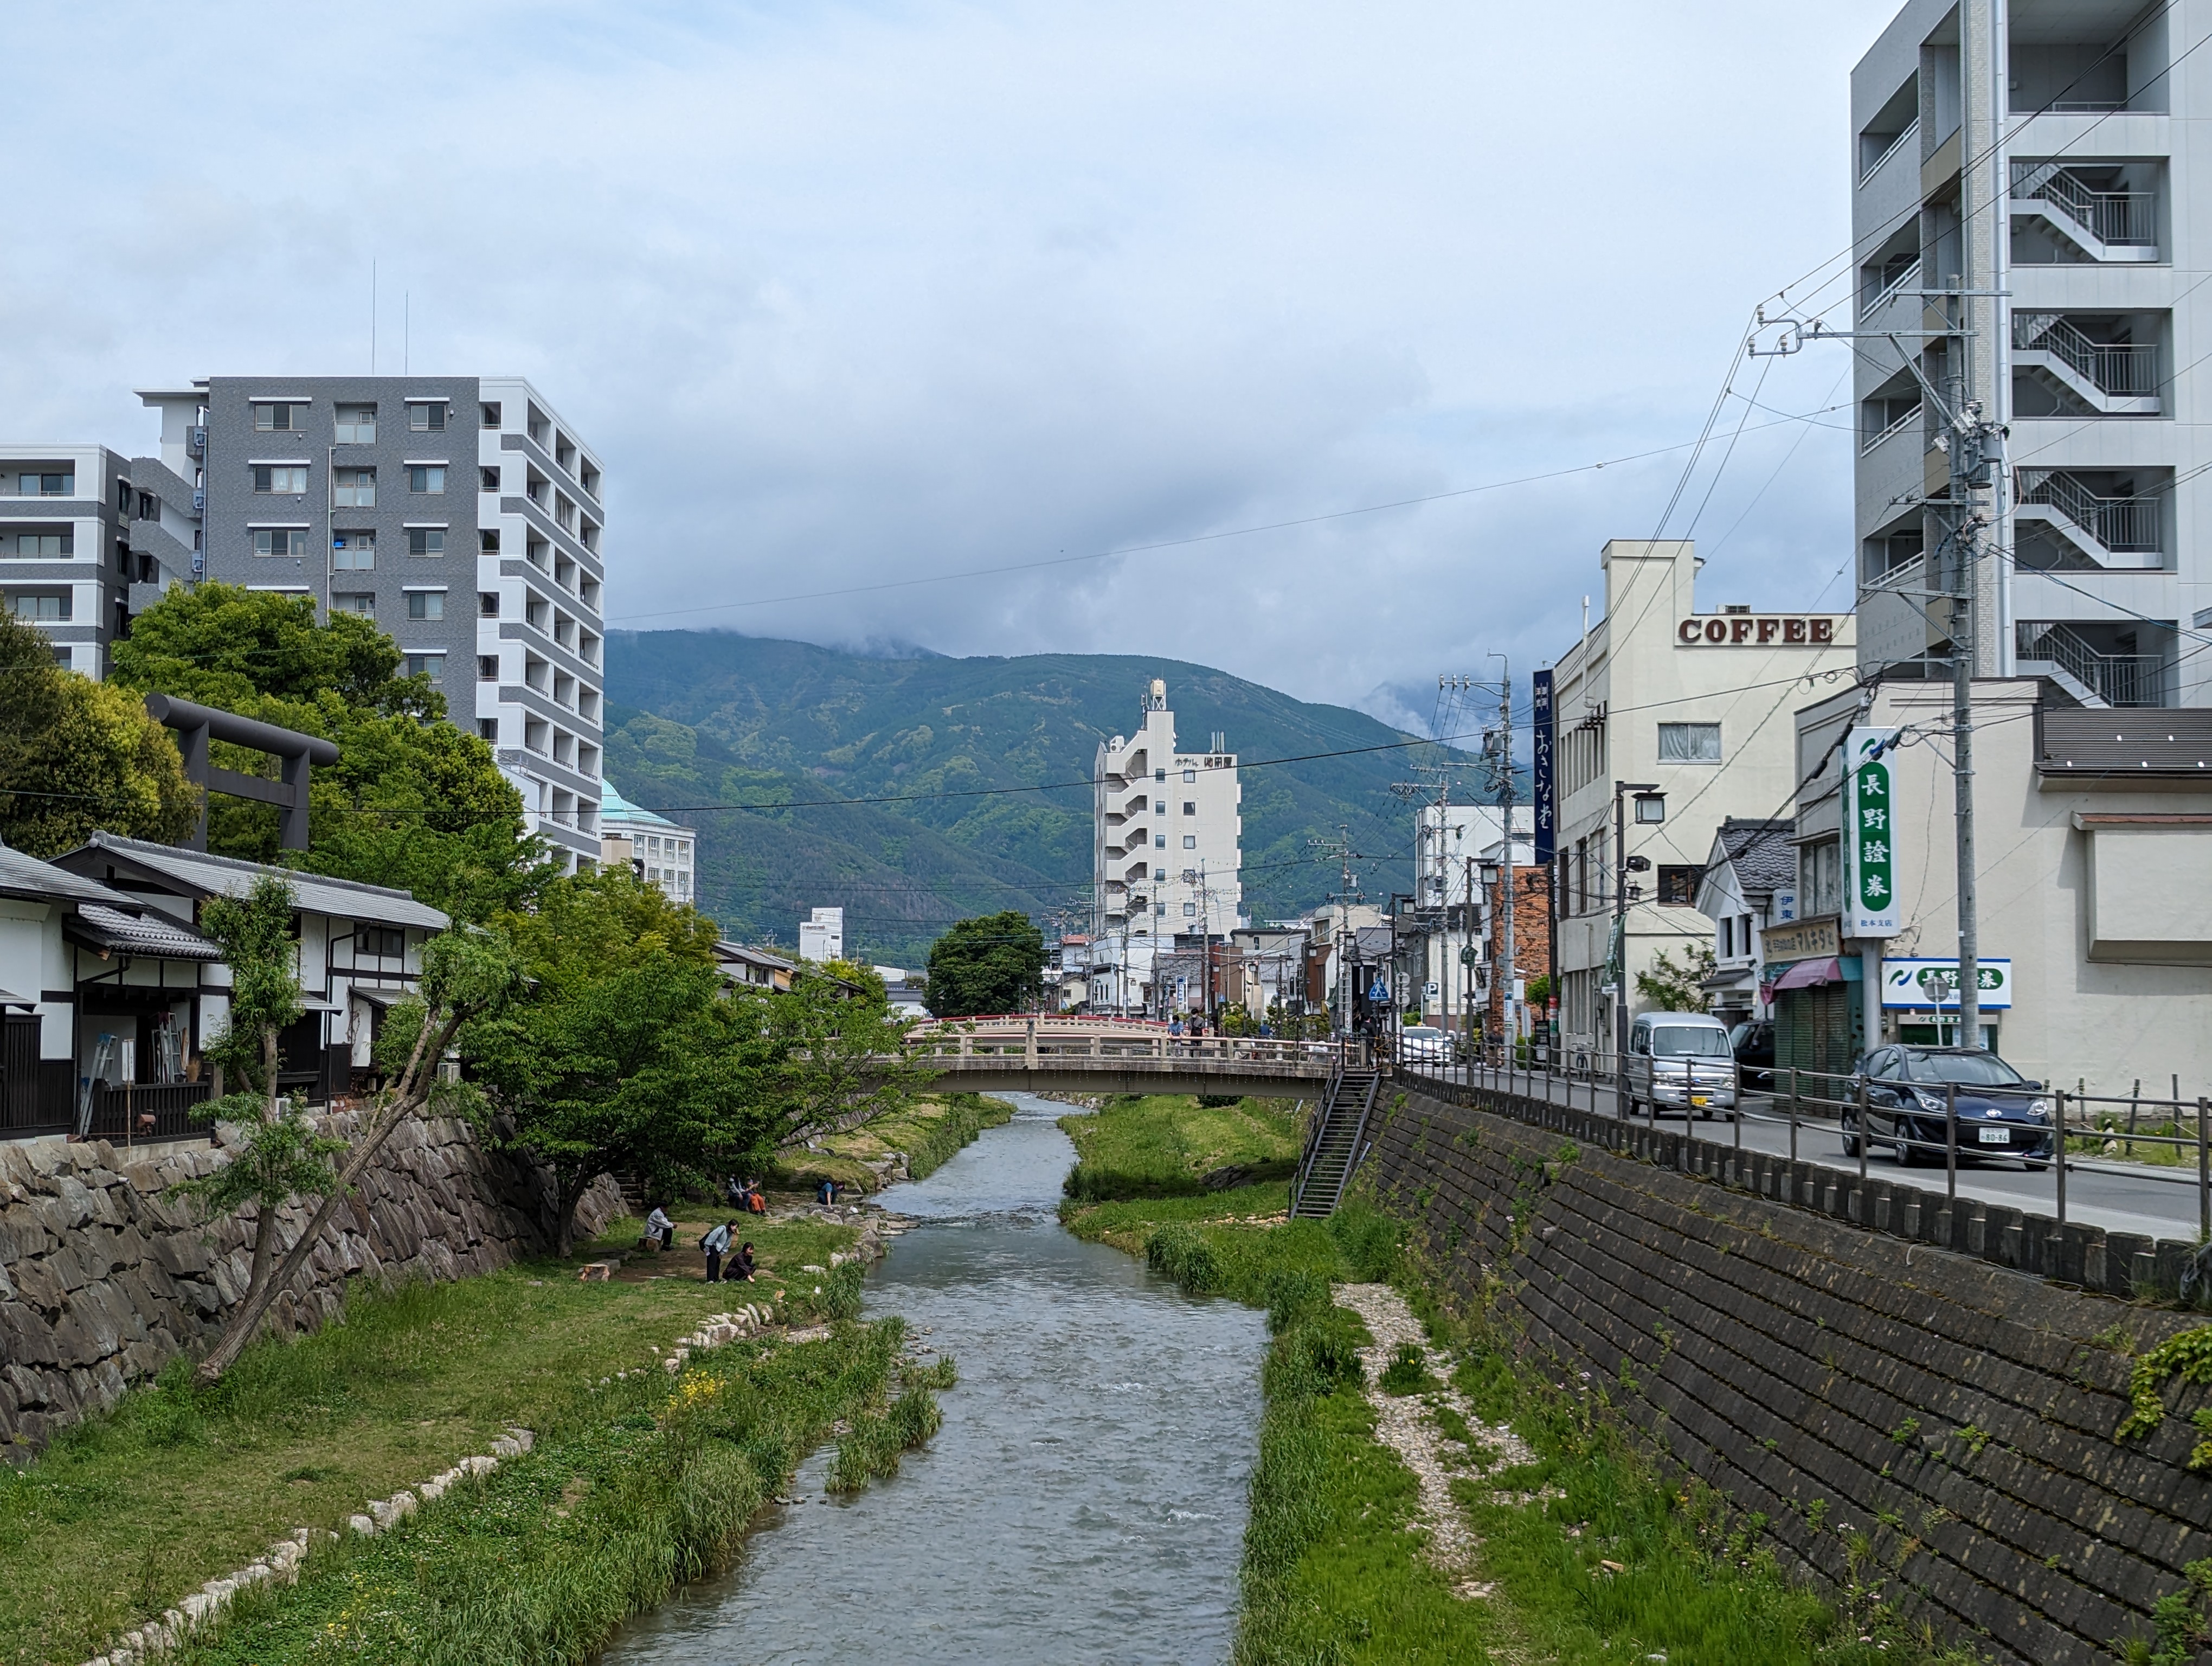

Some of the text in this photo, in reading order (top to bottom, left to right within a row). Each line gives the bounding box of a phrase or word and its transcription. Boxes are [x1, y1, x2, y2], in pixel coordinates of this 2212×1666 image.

[1679, 619, 1832, 643] COFFEE
[1780, 896, 1794, 919] 伊東
[1427, 983, 1437, 994] P
[1986, 1133, 2008, 1142] 80-86
